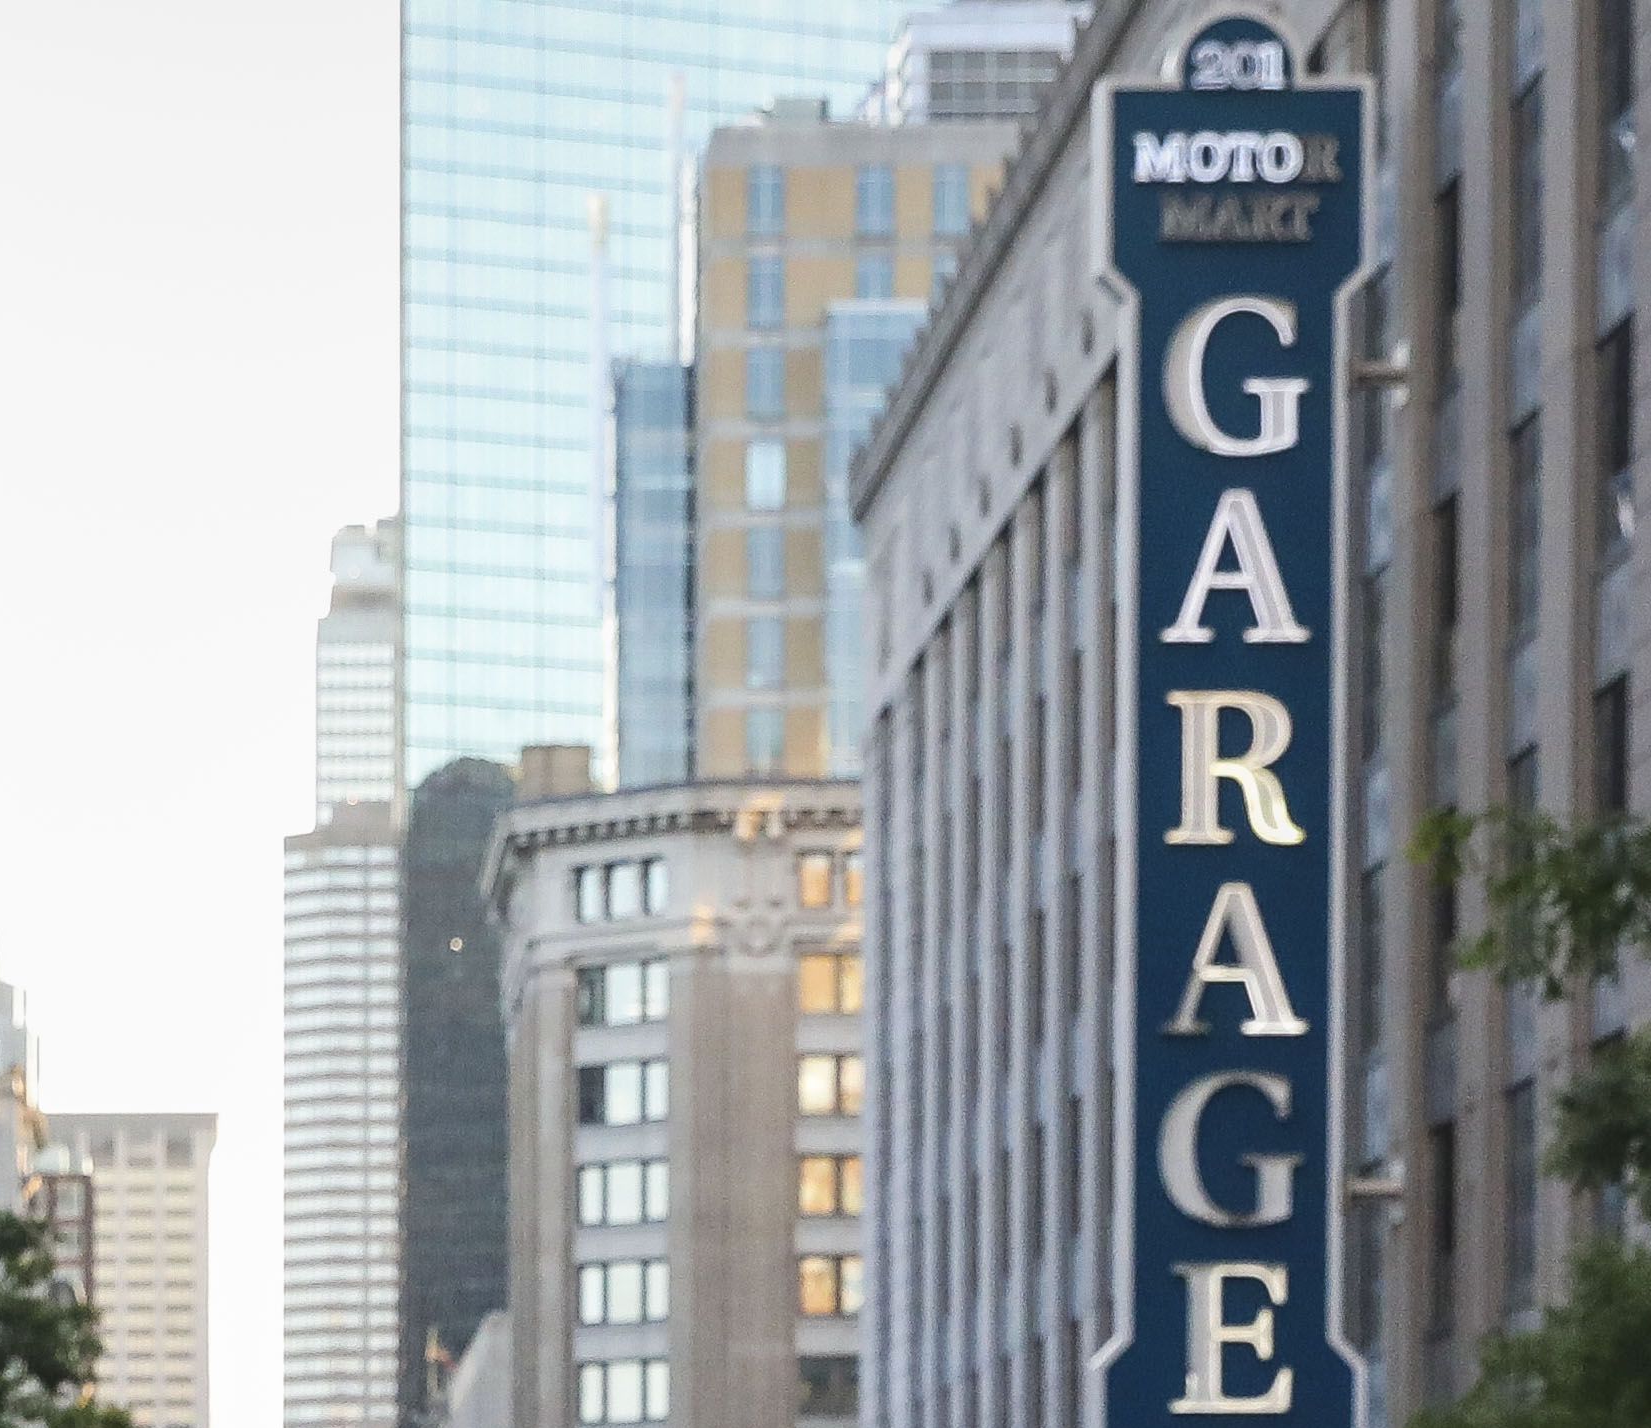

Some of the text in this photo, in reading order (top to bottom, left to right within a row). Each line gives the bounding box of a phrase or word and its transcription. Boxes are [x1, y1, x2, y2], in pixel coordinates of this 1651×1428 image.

[1190, 39, 1287, 91] 201
[1132, 130, 1343, 184] MOTOR
[1158, 190, 1320, 244] MART
[1155, 294, 1311, 1415] GARAGE
